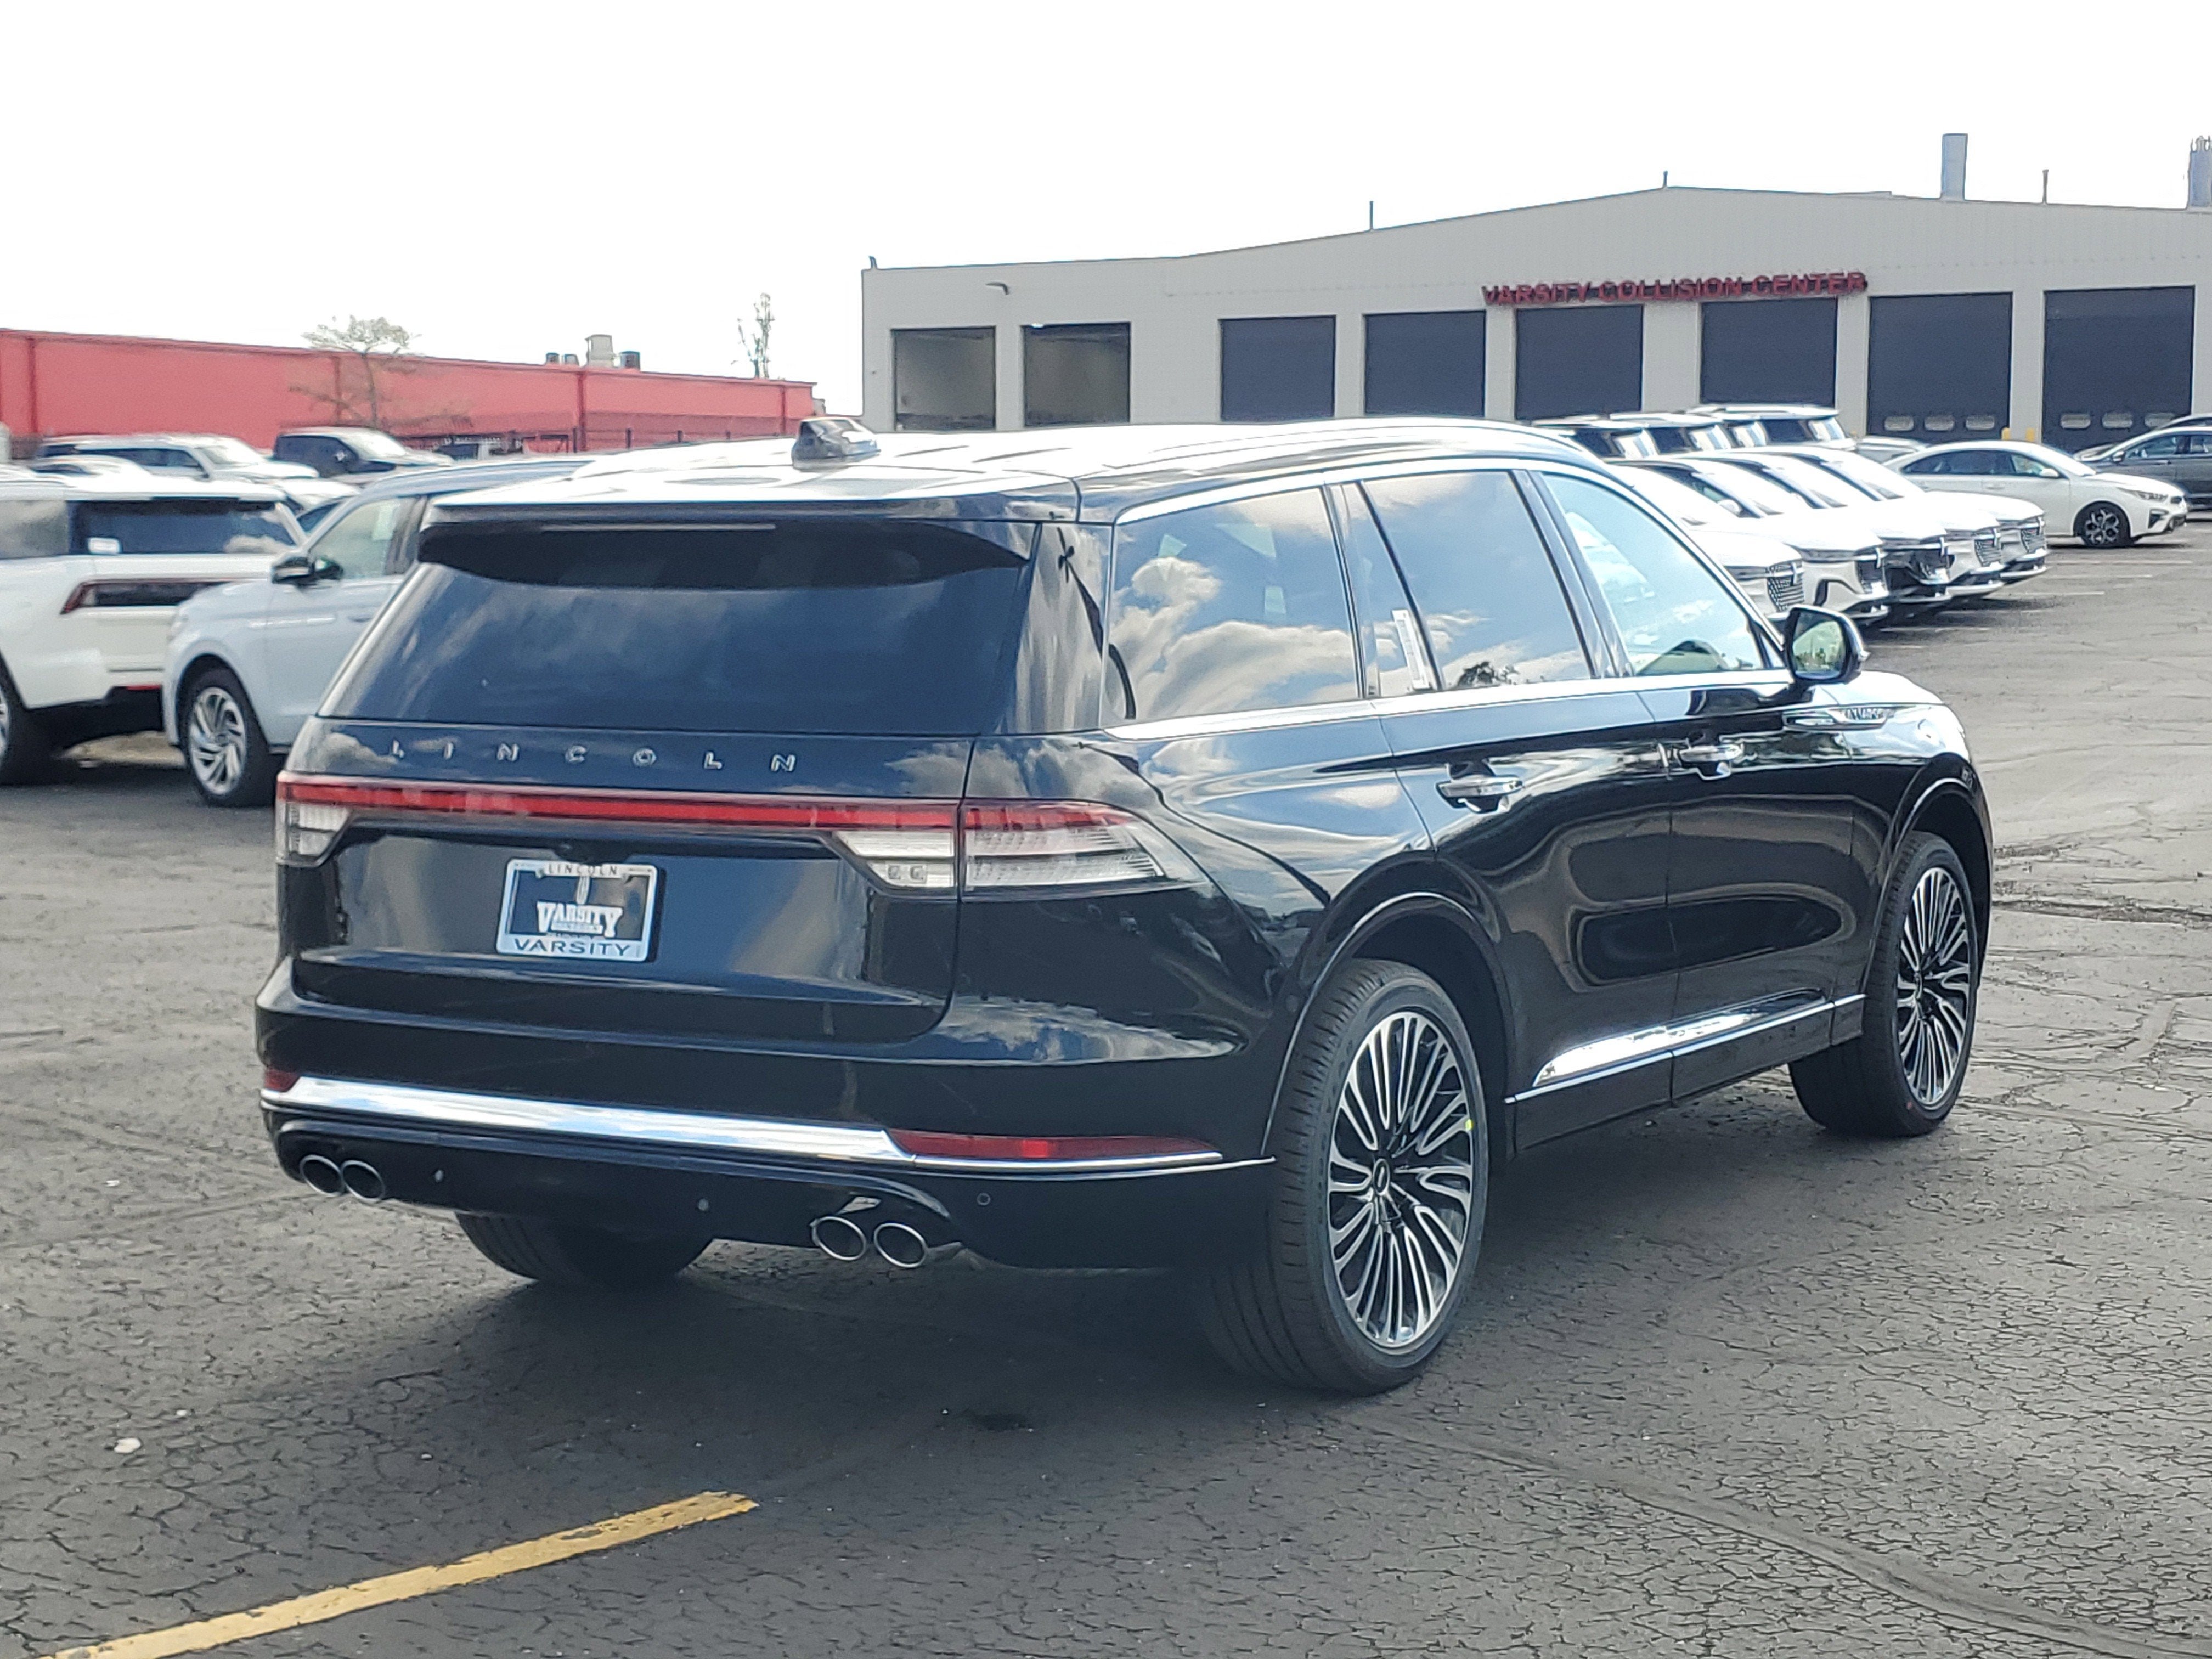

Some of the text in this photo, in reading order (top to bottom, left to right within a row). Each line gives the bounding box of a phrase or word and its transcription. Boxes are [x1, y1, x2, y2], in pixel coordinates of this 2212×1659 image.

[1482, 272, 1867, 305] VARSITY COLLISION CENTER
[391, 739, 795, 772] LINCOLN
[548, 863, 618, 877] LINCOLN
[537, 901, 623, 938] VARSITY
[514, 938, 630, 956] VARSITY
